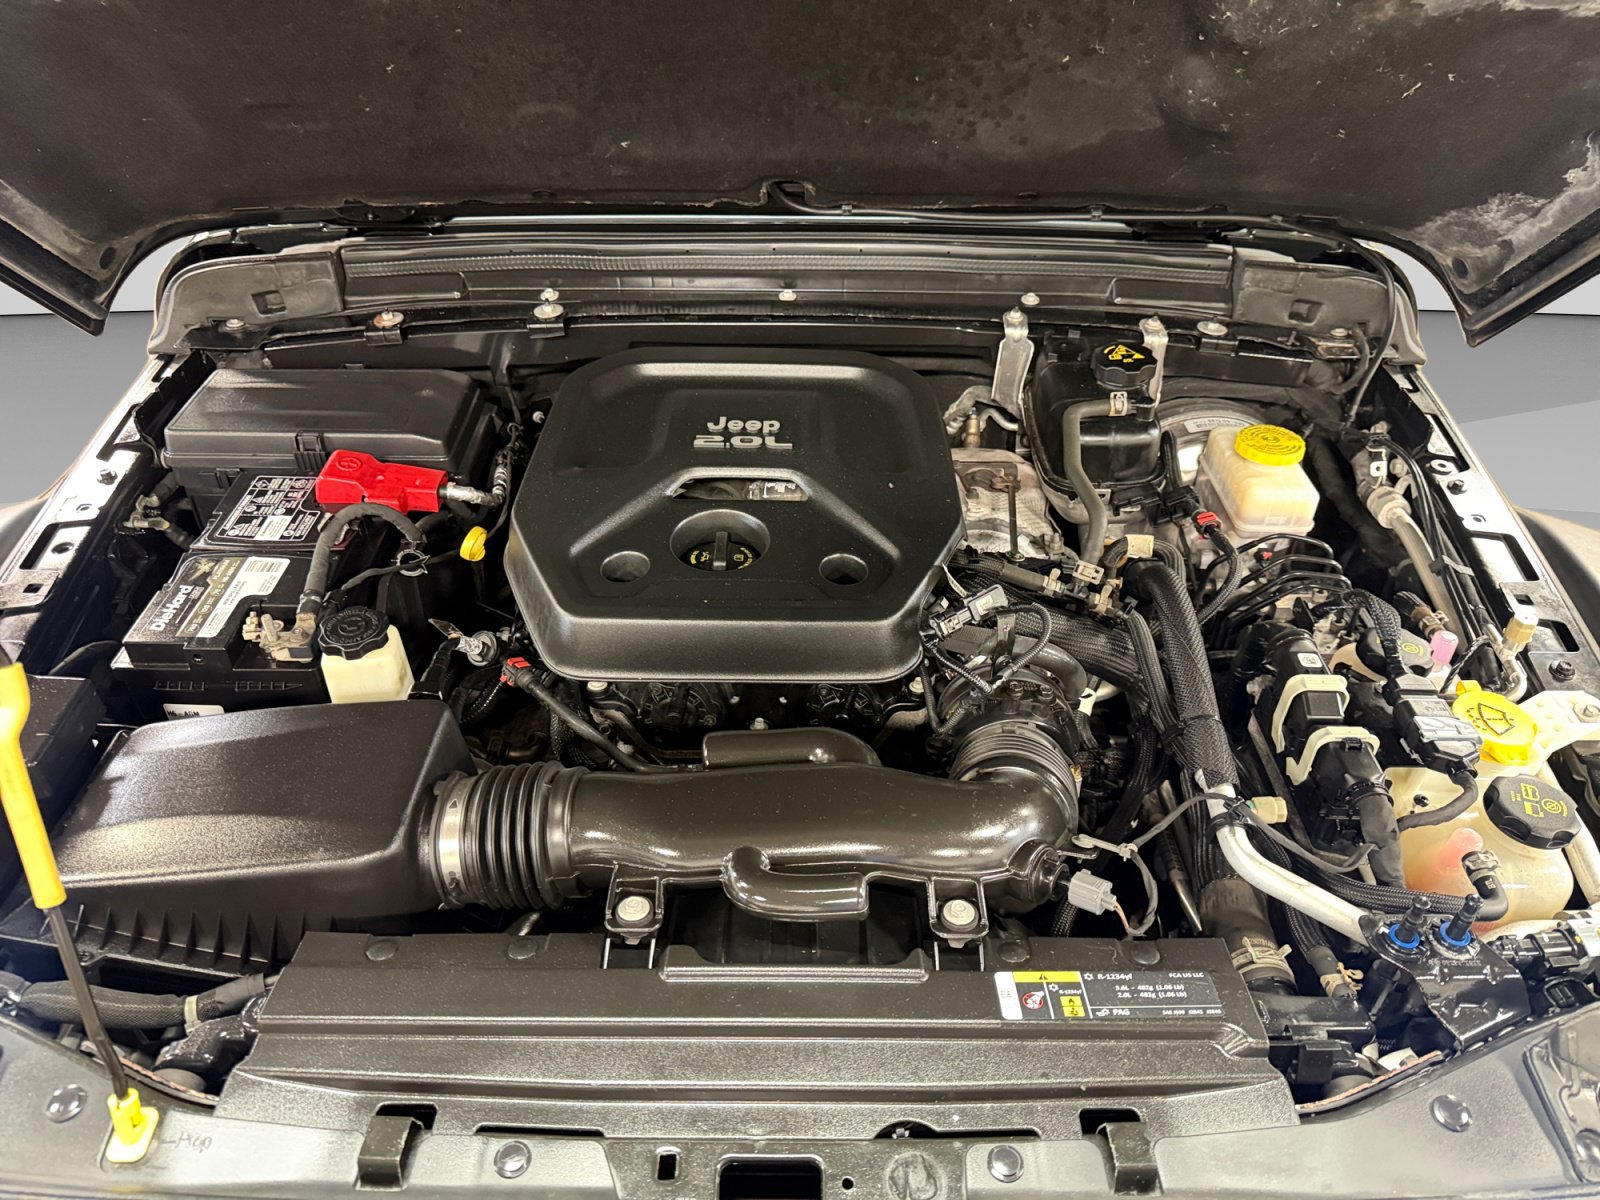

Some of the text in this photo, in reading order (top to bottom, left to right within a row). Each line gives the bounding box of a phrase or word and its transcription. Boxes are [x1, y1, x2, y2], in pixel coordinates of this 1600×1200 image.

[706, 415, 781, 433] Jeep
[693, 434, 793, 450] 2.0L
[150, 585, 194, 631] DieHard
[1097, 973, 1133, 981] R-1234yf
[1112, 1008, 1131, 1016] PAG
